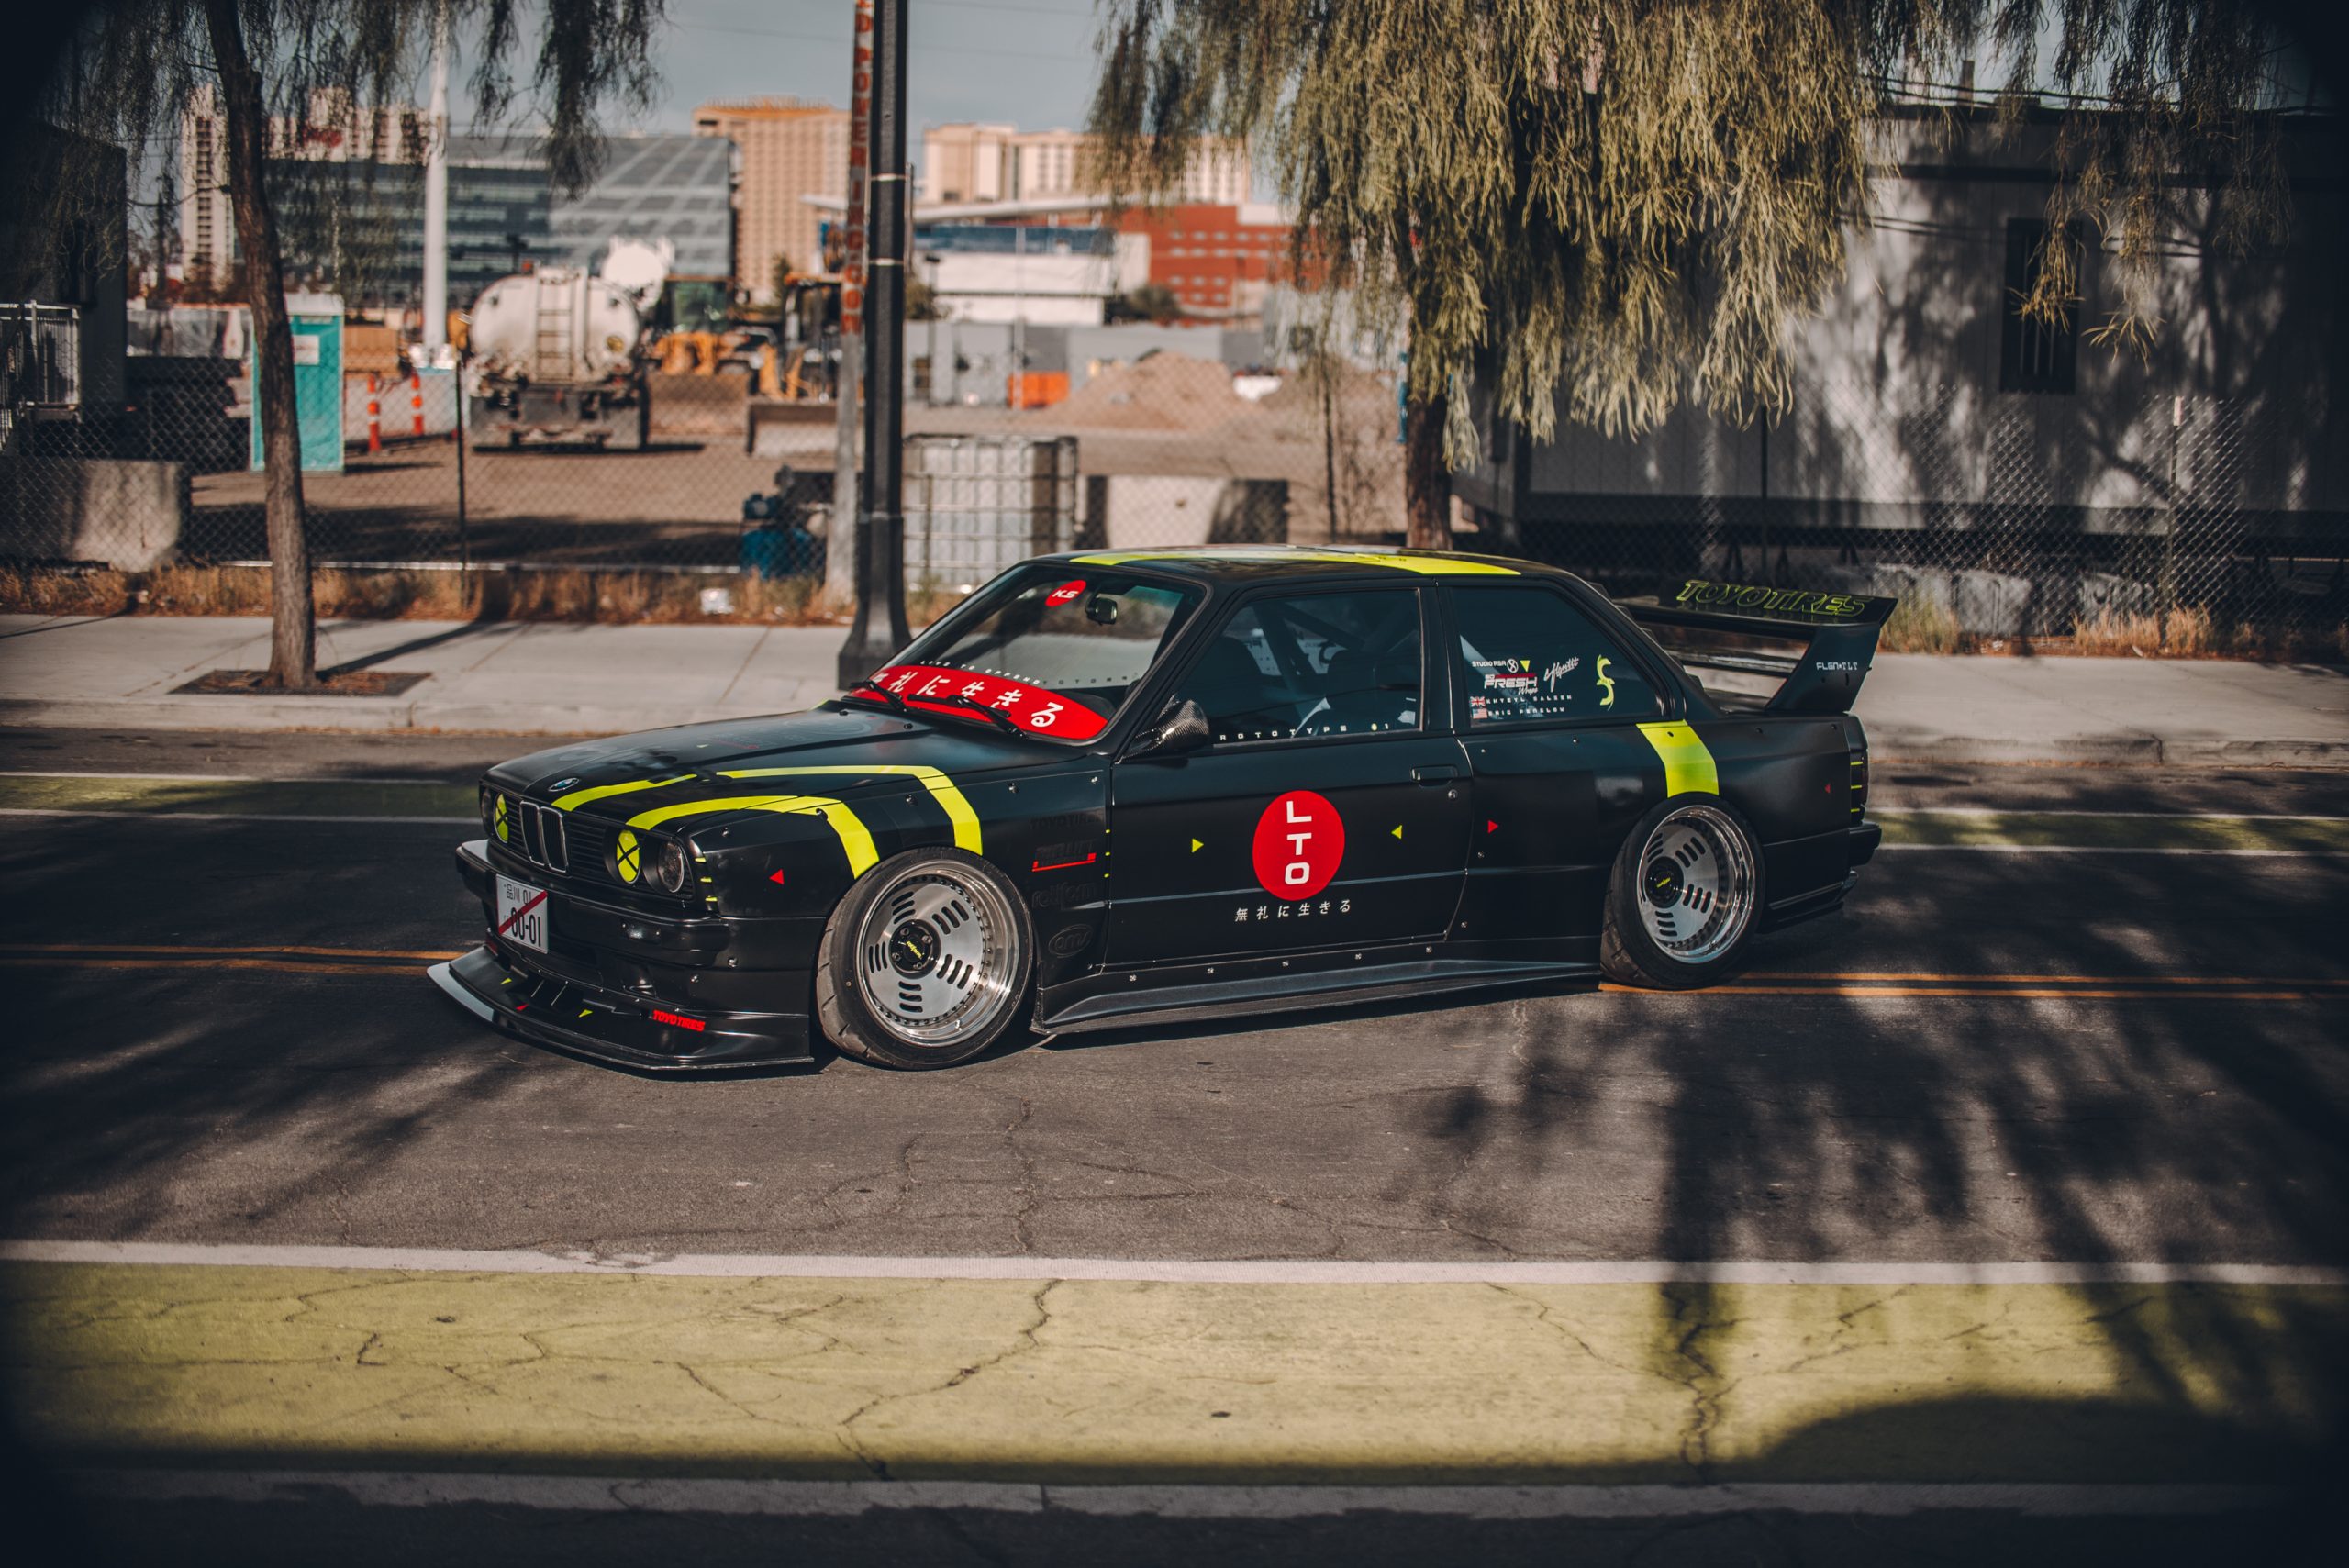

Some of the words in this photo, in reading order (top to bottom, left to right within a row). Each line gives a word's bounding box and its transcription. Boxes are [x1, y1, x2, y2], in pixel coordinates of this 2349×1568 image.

[1484, 676, 1538, 690] FRESH
[1234, 898, 1351, 923] 無礼に生きる
